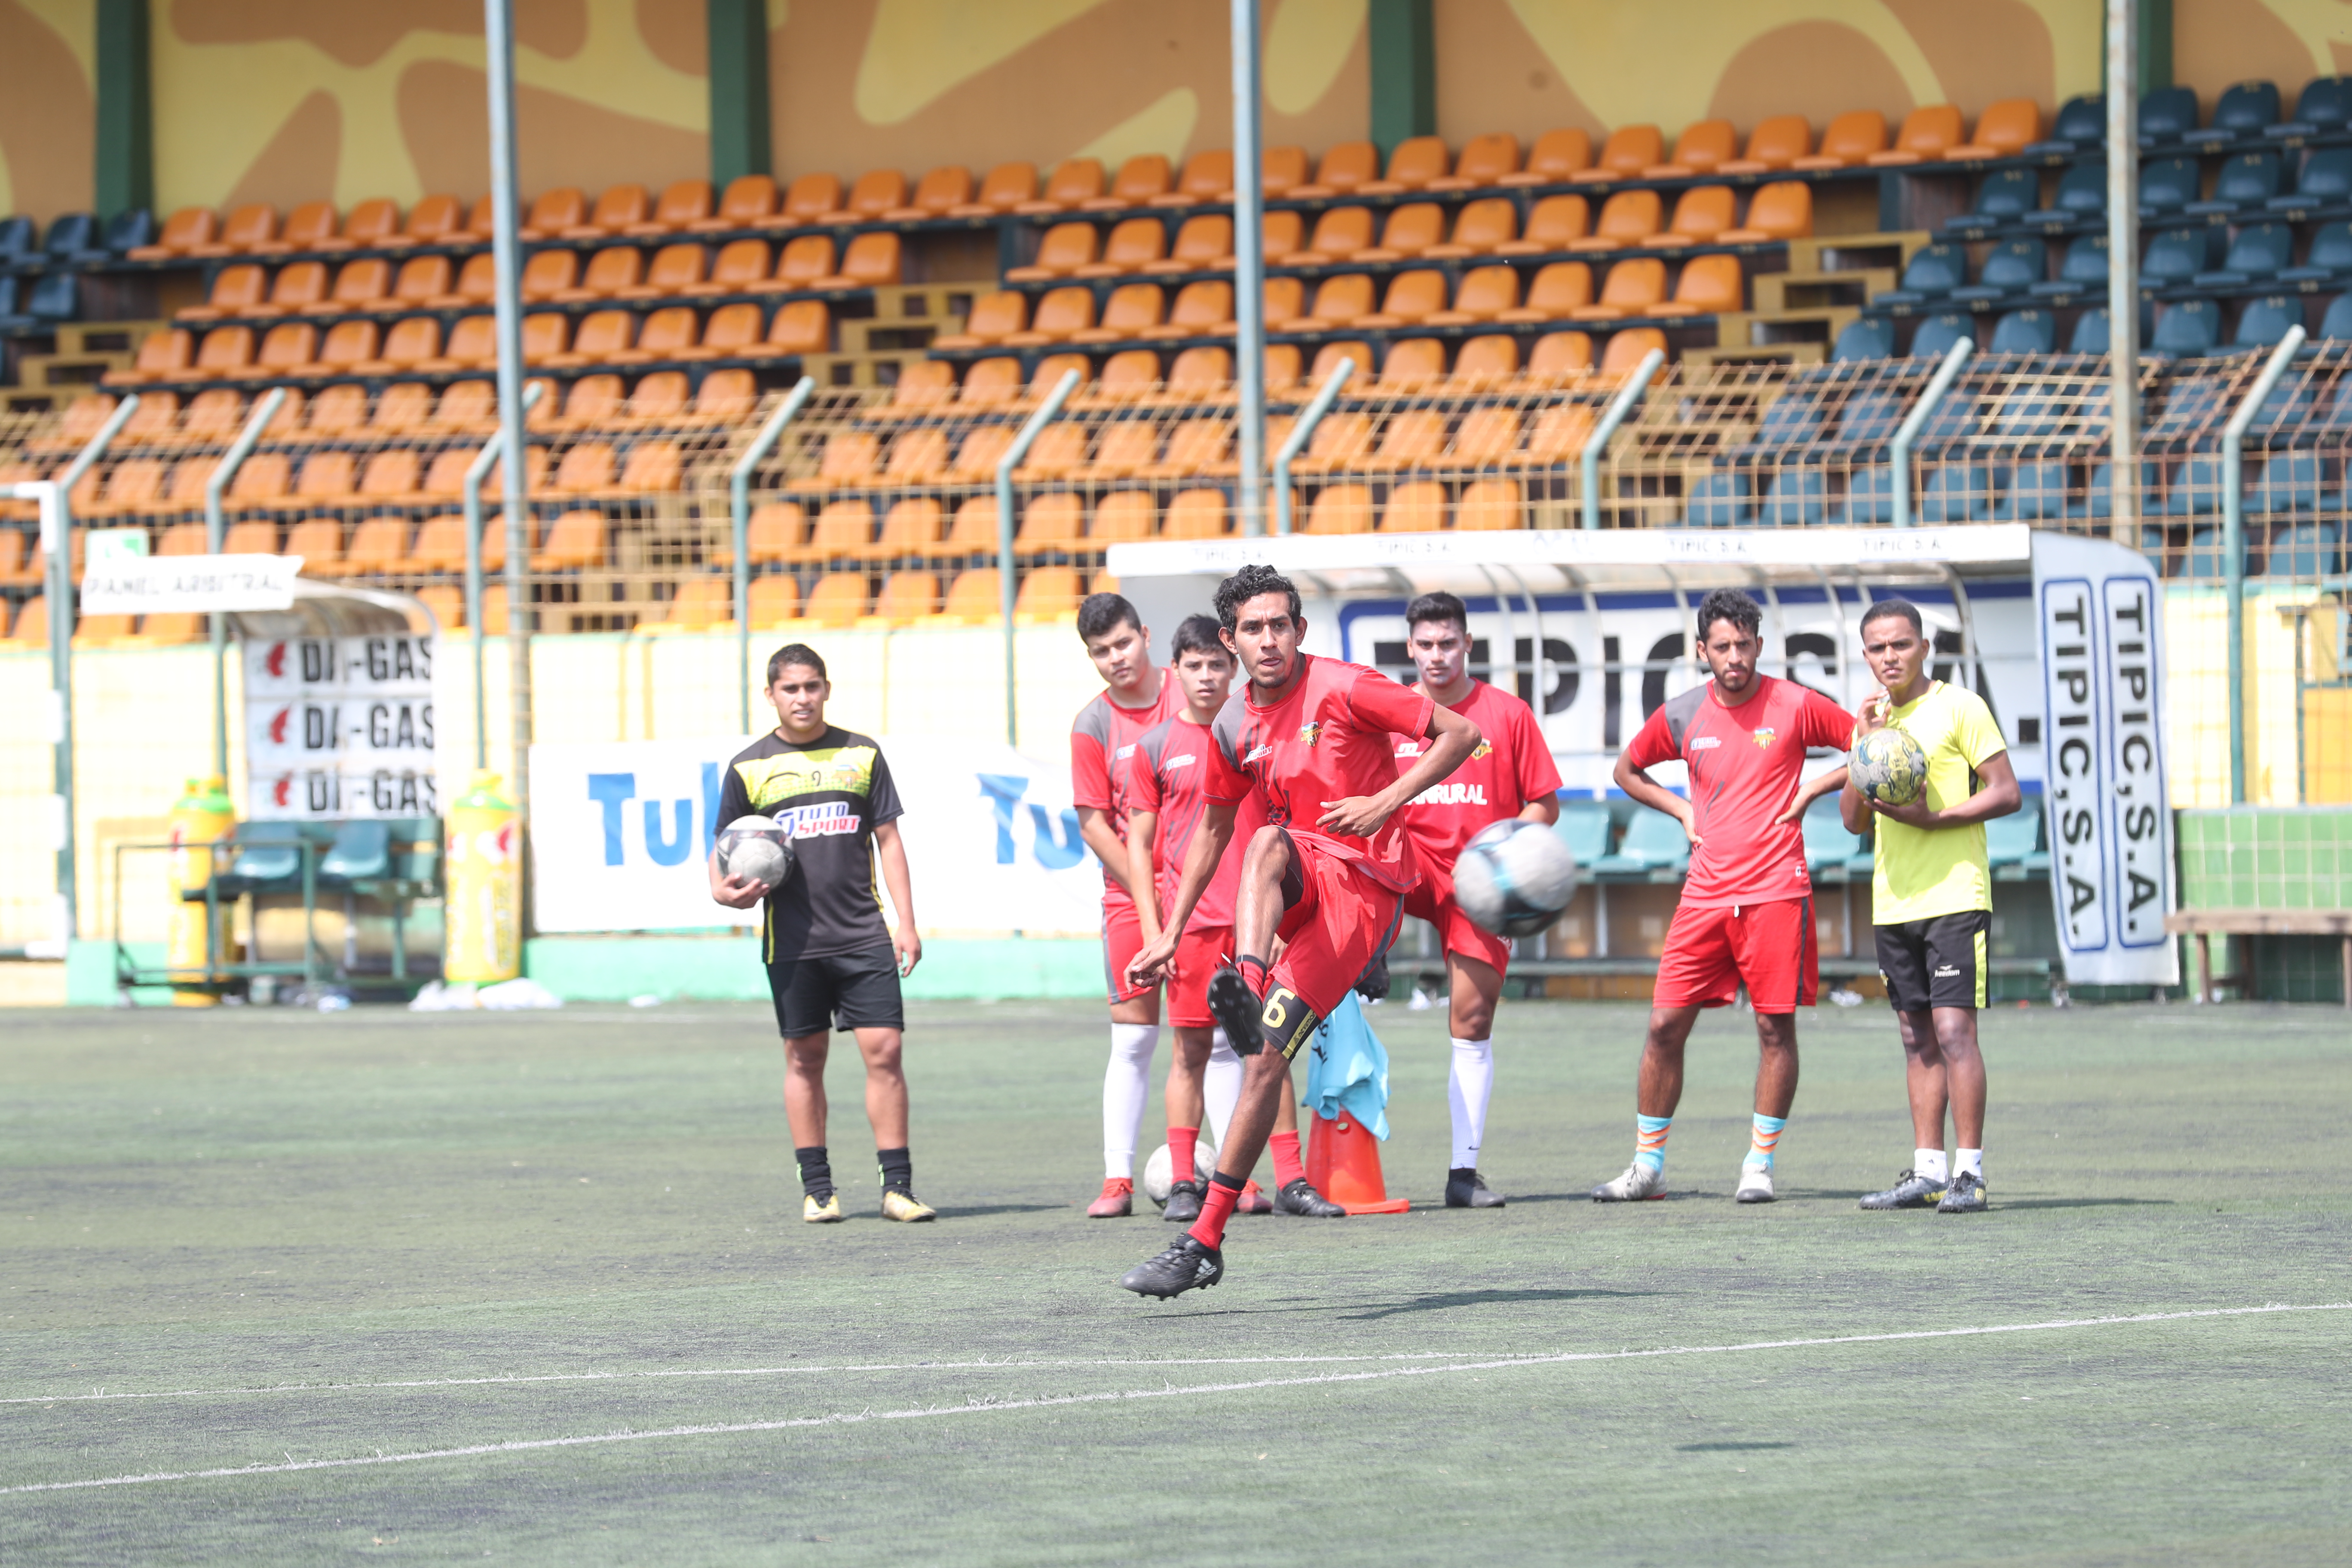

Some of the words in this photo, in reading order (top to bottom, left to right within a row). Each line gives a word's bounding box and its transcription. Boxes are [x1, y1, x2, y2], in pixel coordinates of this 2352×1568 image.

[1404, 783, 1488, 805] NRURAL
[799, 804, 845, 821] TUTO
[798, 818, 859, 836] SPORT
[1262, 988, 1295, 1028] 6
